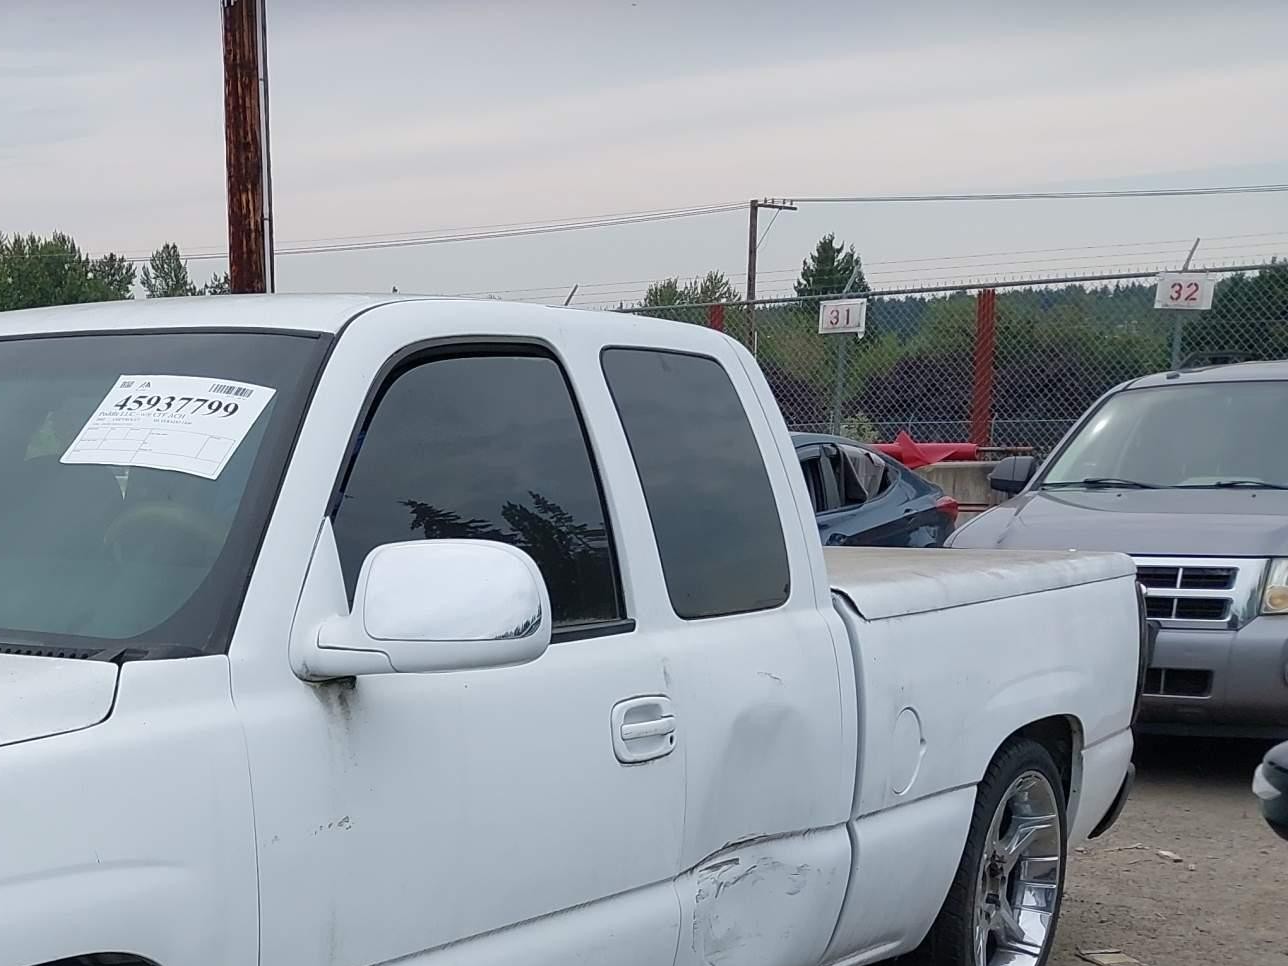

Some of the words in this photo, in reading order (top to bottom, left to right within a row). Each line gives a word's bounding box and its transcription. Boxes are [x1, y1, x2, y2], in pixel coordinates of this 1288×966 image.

[1170, 282, 1199, 302] 32
[830, 308, 850, 326] 31
[114, 394, 239, 418] 45937799
